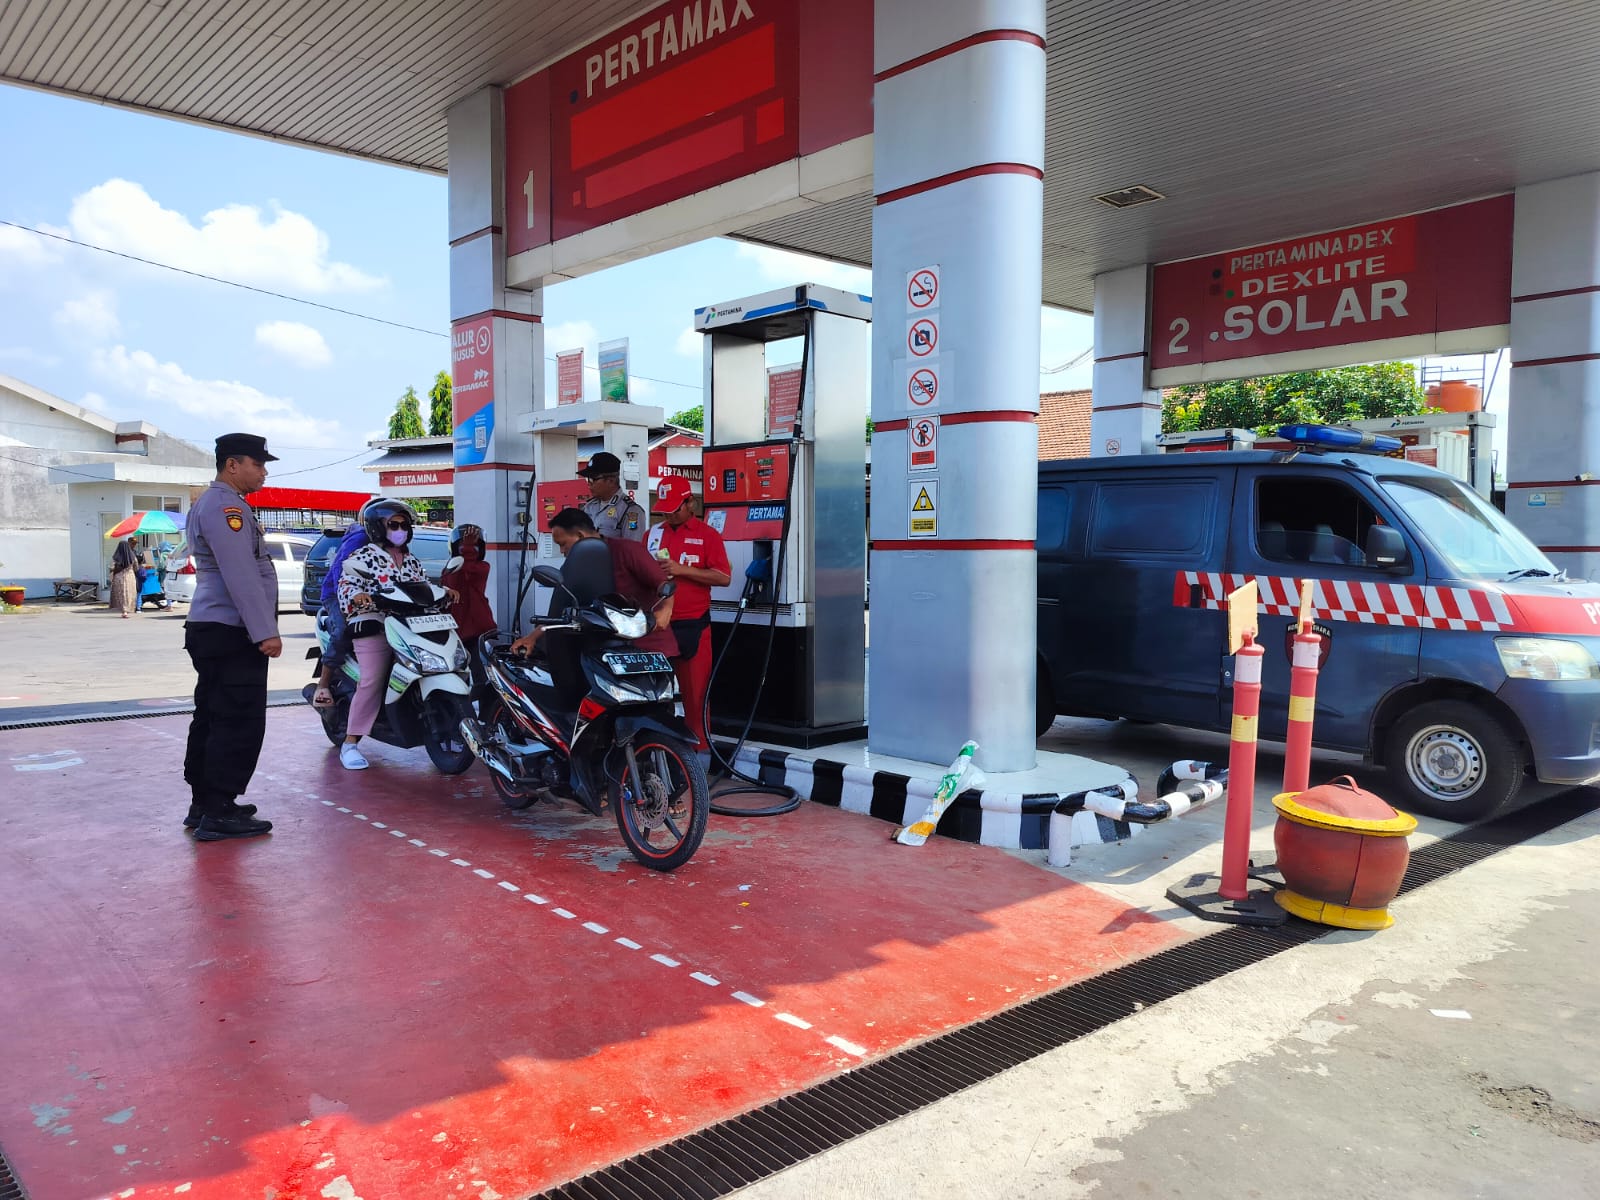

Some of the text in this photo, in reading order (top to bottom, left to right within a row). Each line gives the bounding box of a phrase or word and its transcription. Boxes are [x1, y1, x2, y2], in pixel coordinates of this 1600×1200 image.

[586, 0, 755, 98] PERTAMAX
[523, 170, 534, 229] 1
[1241, 255, 1386, 298] DEXLITE
[717, 306, 743, 317] PERTAMINA
[1223, 279, 1409, 341] SOLAR
[1168, 318, 1190, 355] 2
[394, 473, 438, 485] PERTAMINA
[658, 465, 703, 481] PERTAMINA
[709, 475, 717, 491] 9
